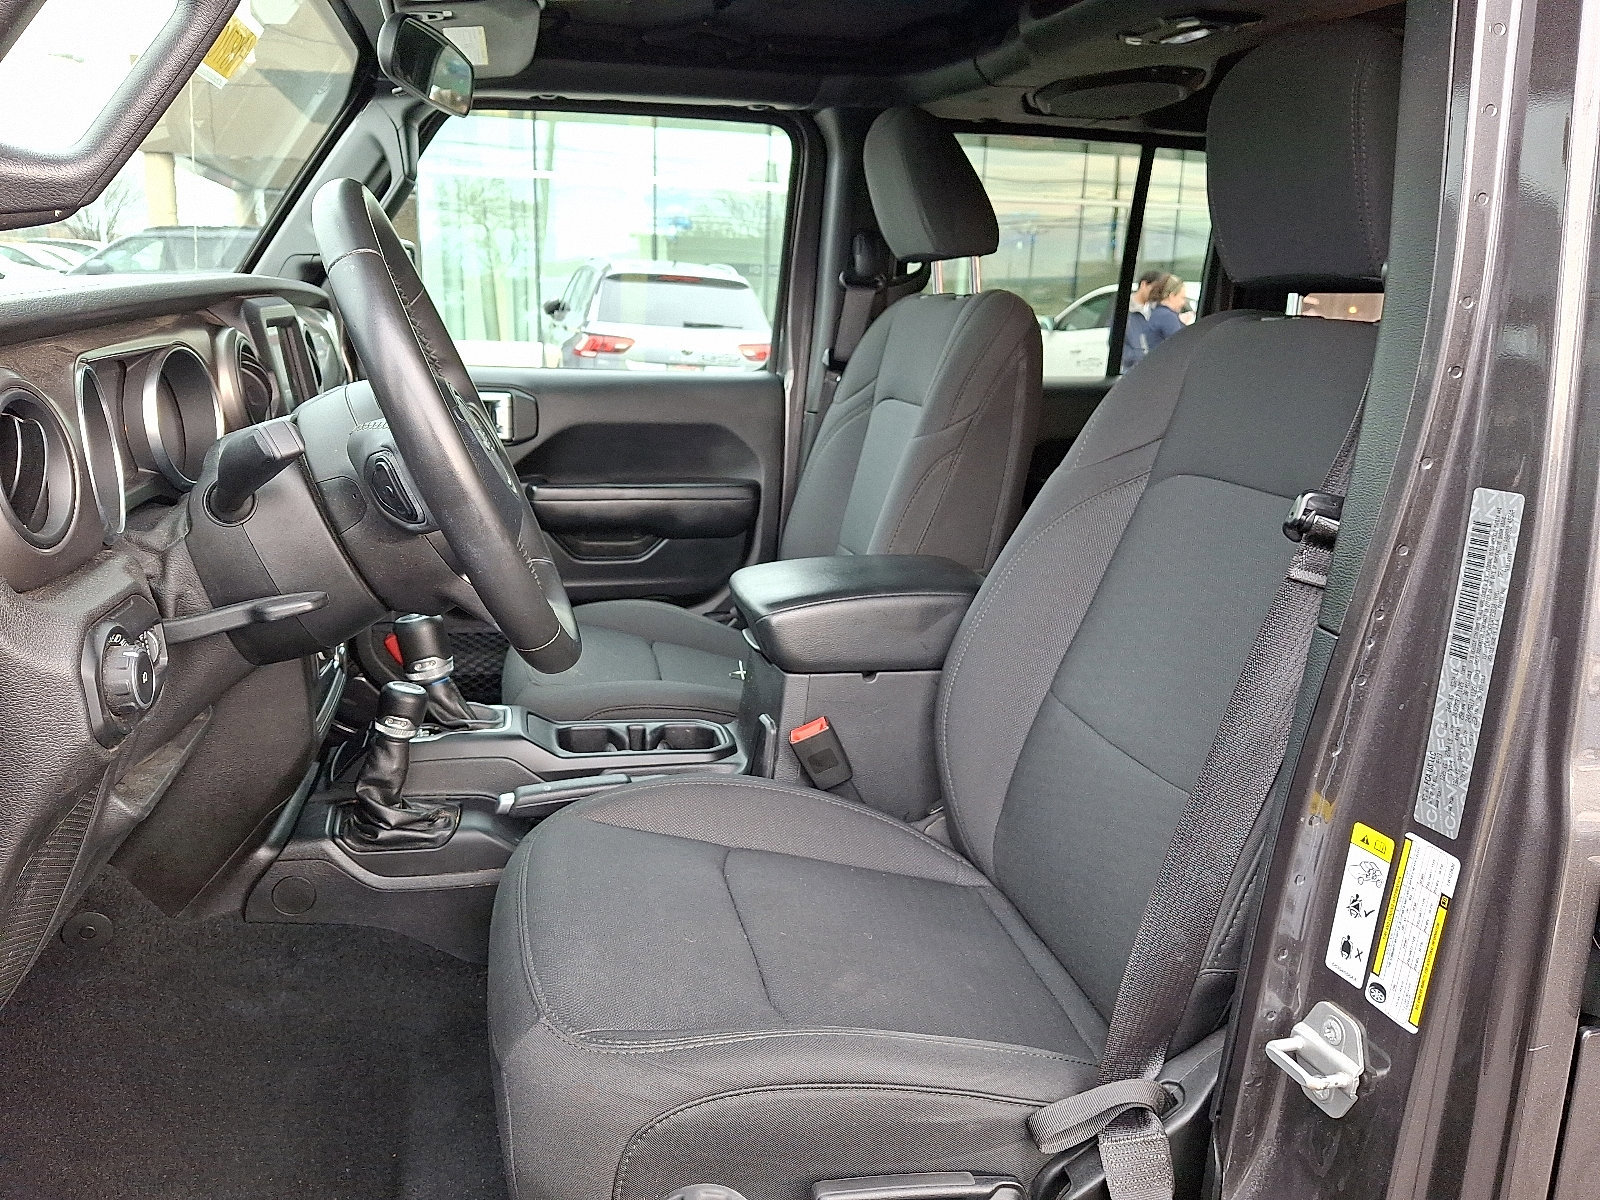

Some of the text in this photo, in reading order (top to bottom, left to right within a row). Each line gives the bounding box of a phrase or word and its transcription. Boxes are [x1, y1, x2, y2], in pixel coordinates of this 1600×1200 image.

[1428, 749, 1436, 763] LLC
[1426, 762, 1434, 773] US
[1423, 772, 1431, 786] FCA
